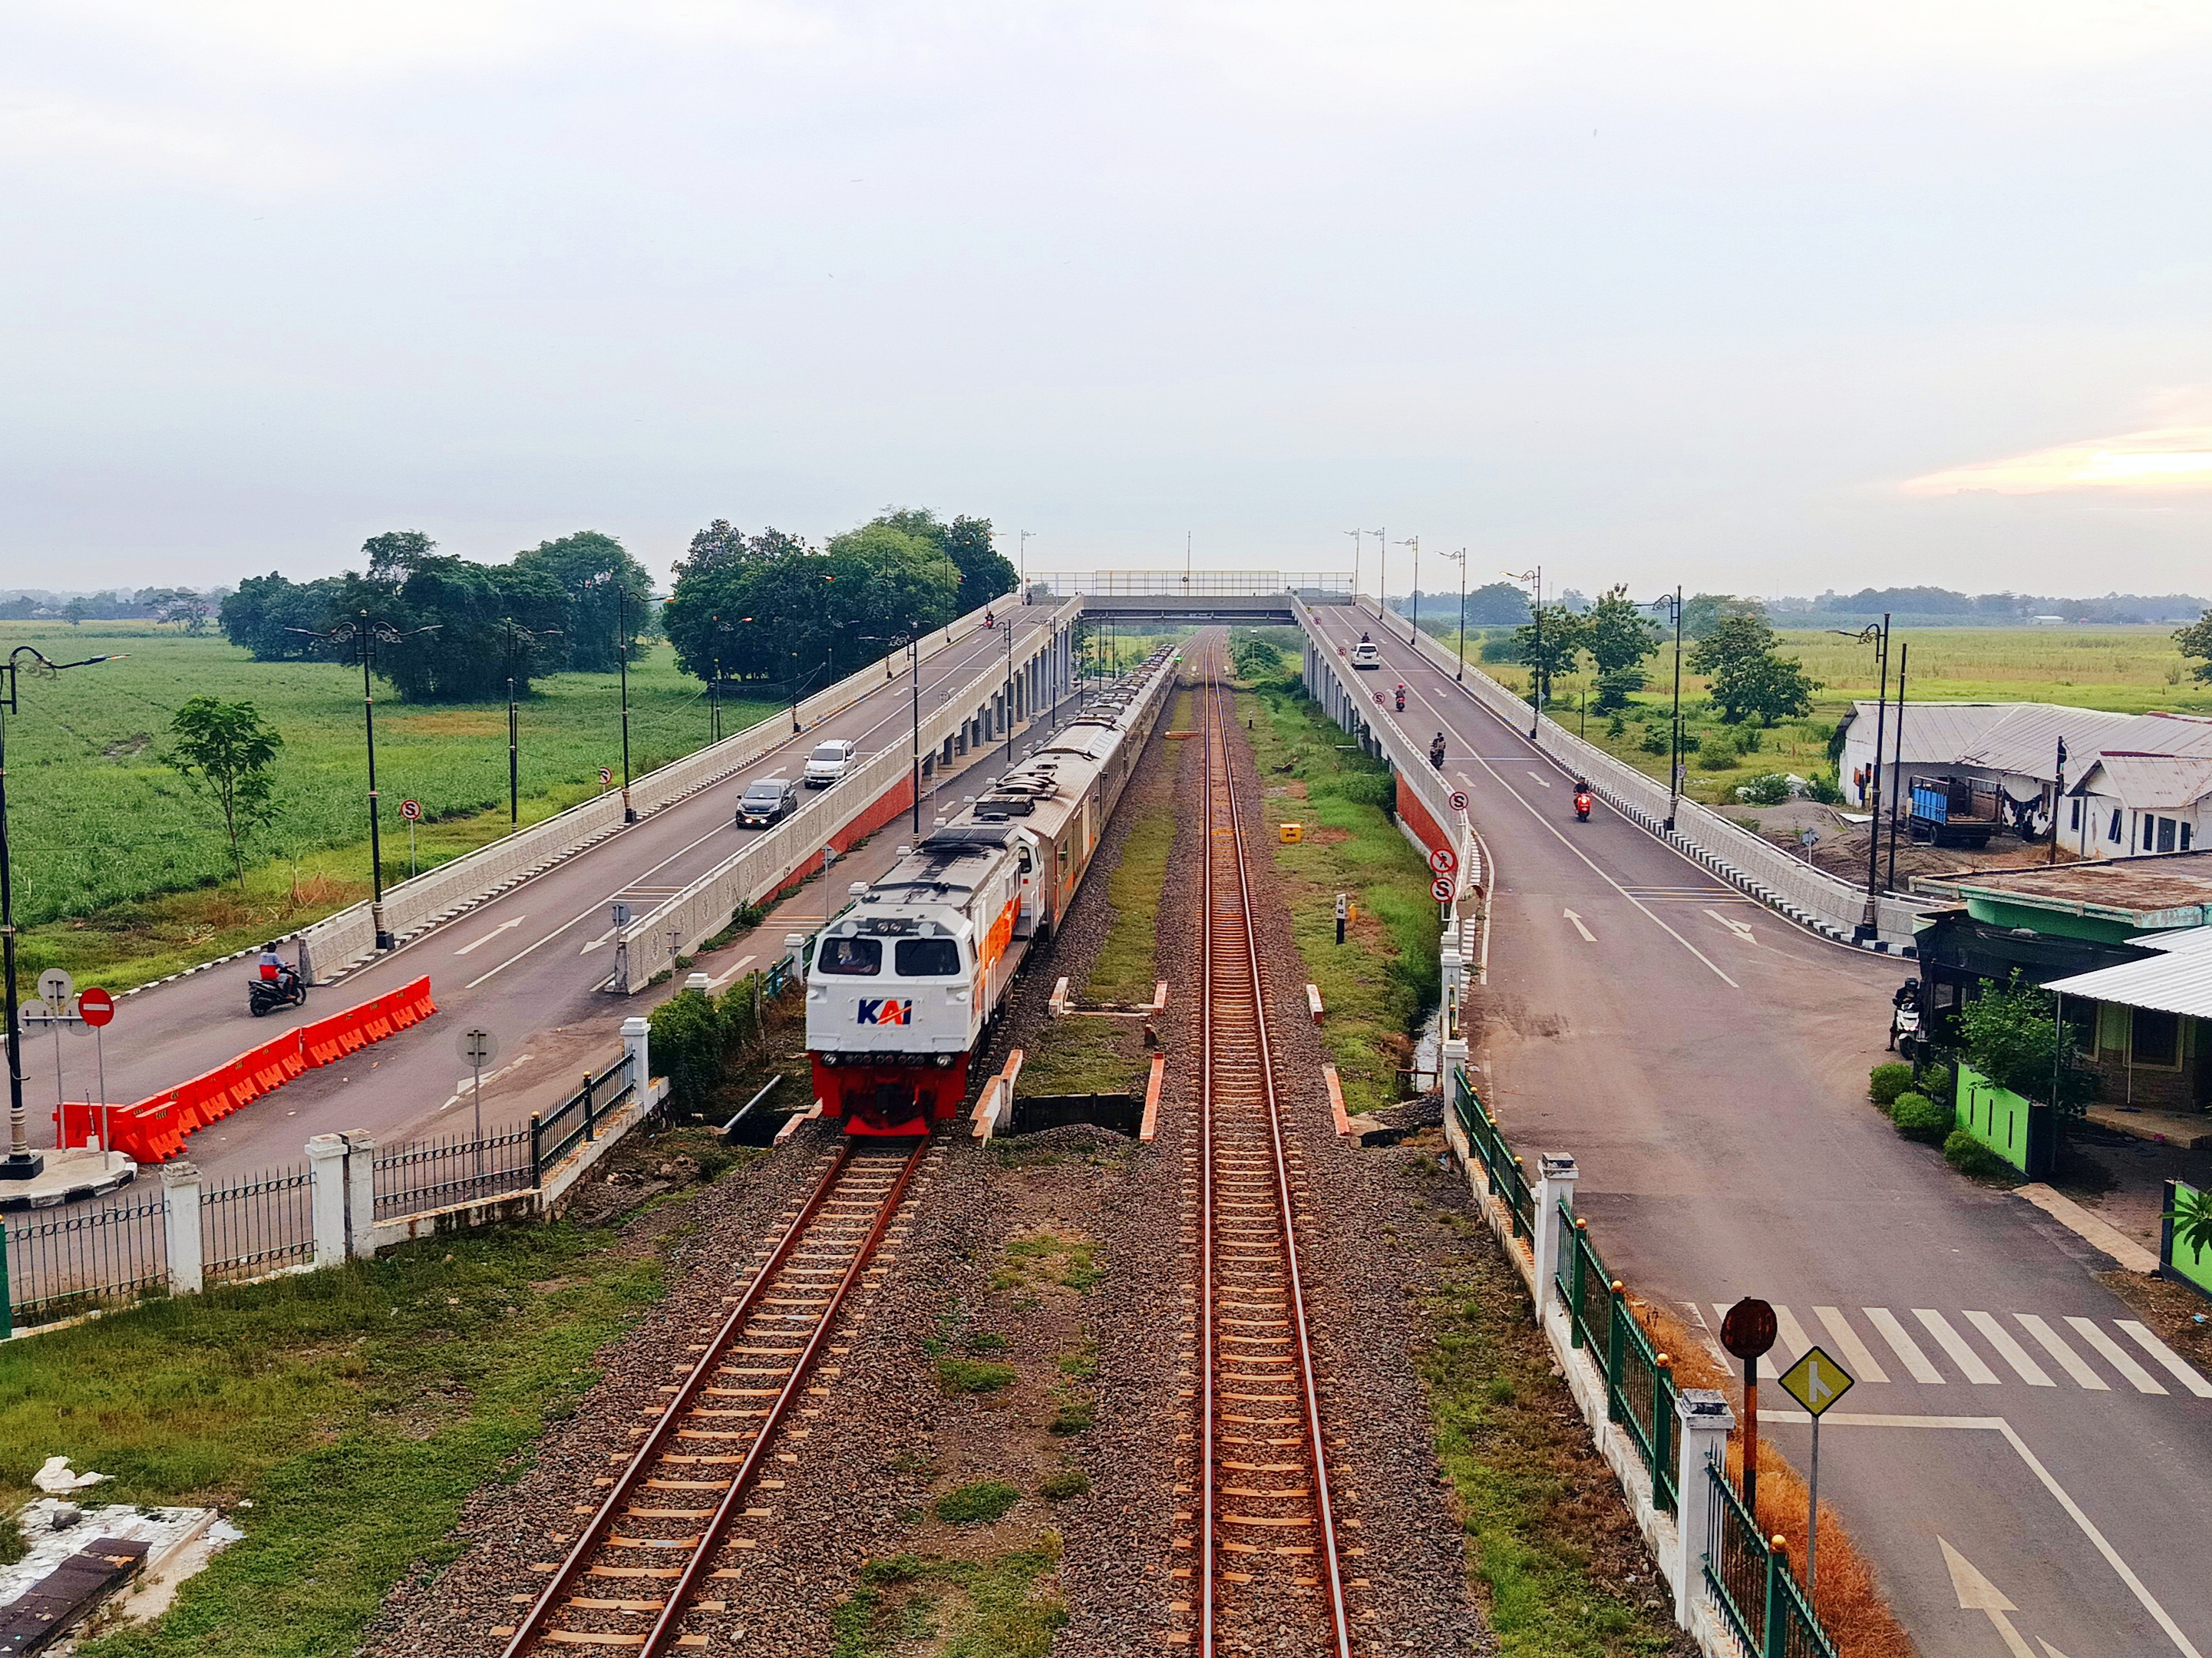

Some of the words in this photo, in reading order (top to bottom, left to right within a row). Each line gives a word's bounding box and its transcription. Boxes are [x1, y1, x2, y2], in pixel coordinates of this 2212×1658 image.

[1454, 795, 1464, 808] S
[405, 803, 415, 815] S
[1435, 881, 1449, 897] S
[857, 999, 912, 1025] KAI
